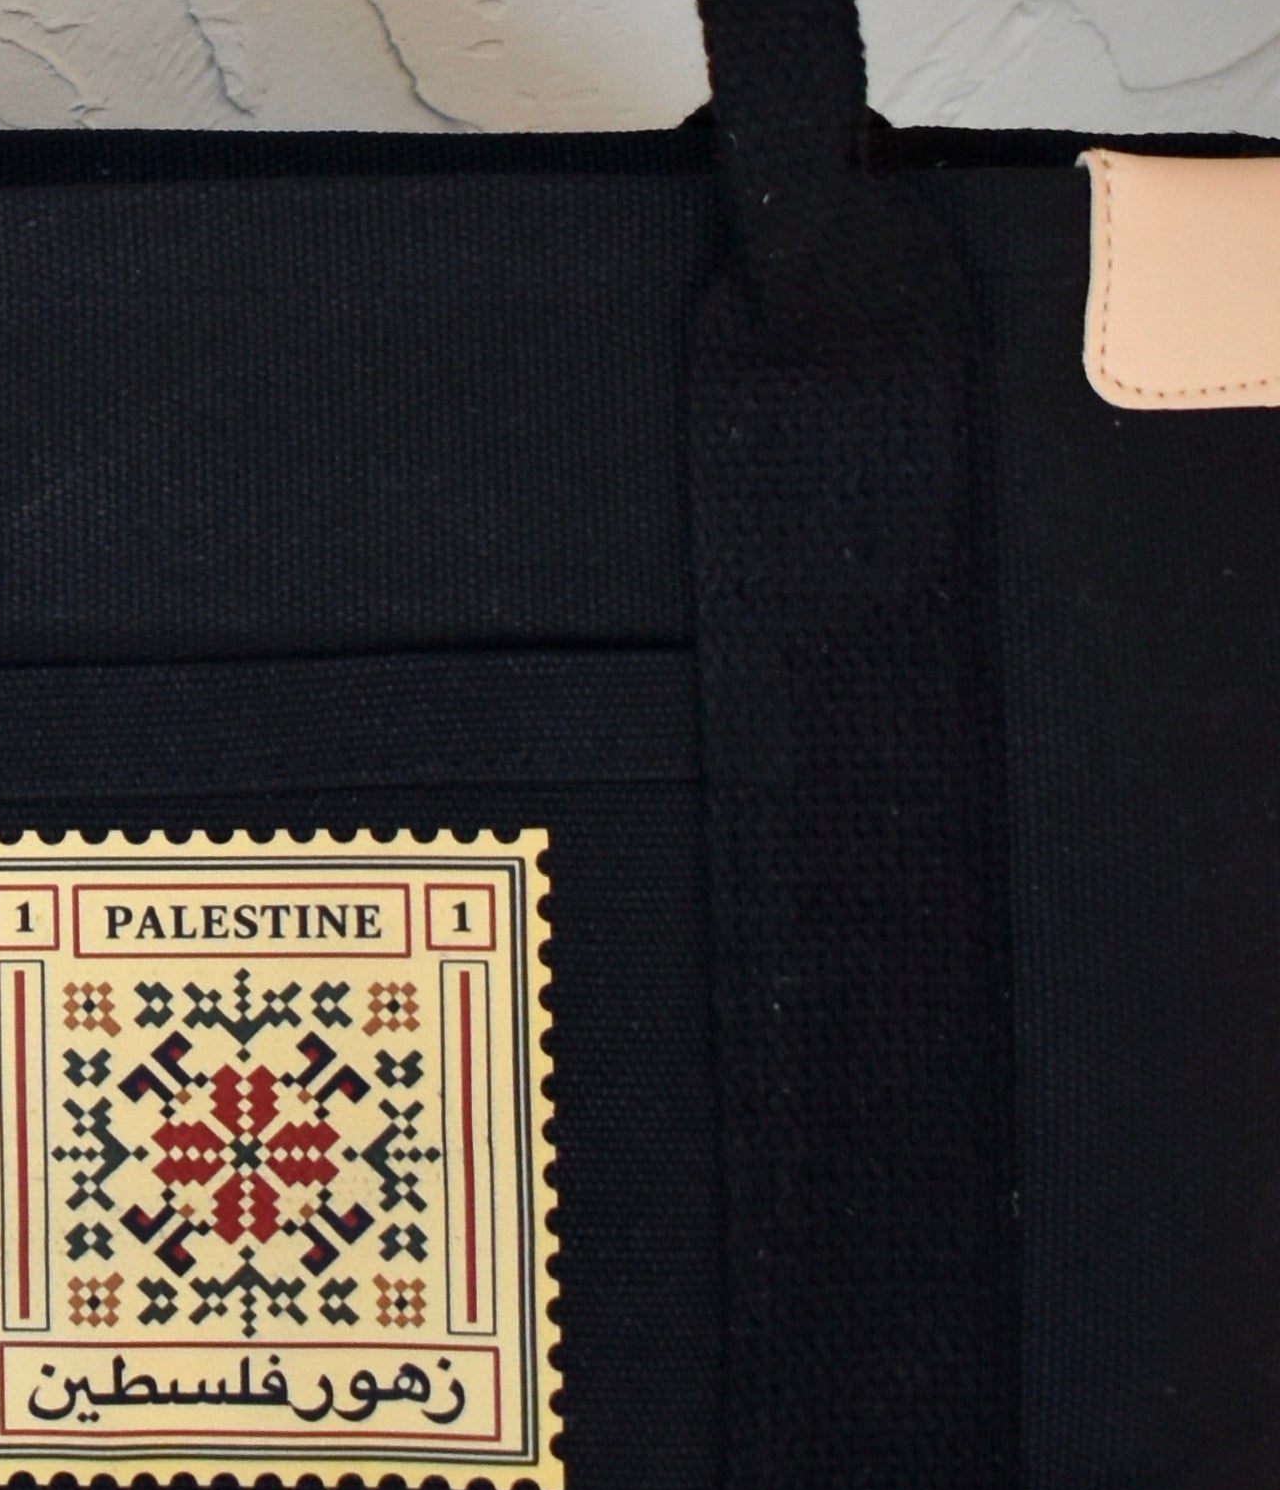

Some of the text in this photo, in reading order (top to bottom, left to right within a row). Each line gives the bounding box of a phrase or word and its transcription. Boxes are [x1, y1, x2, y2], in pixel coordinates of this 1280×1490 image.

[15, 902, 34, 933] 1
[105, 904, 383, 940] PALESTINE
[451, 902, 471, 932] 1
[27, 1354, 292, 1422] فلسطين
